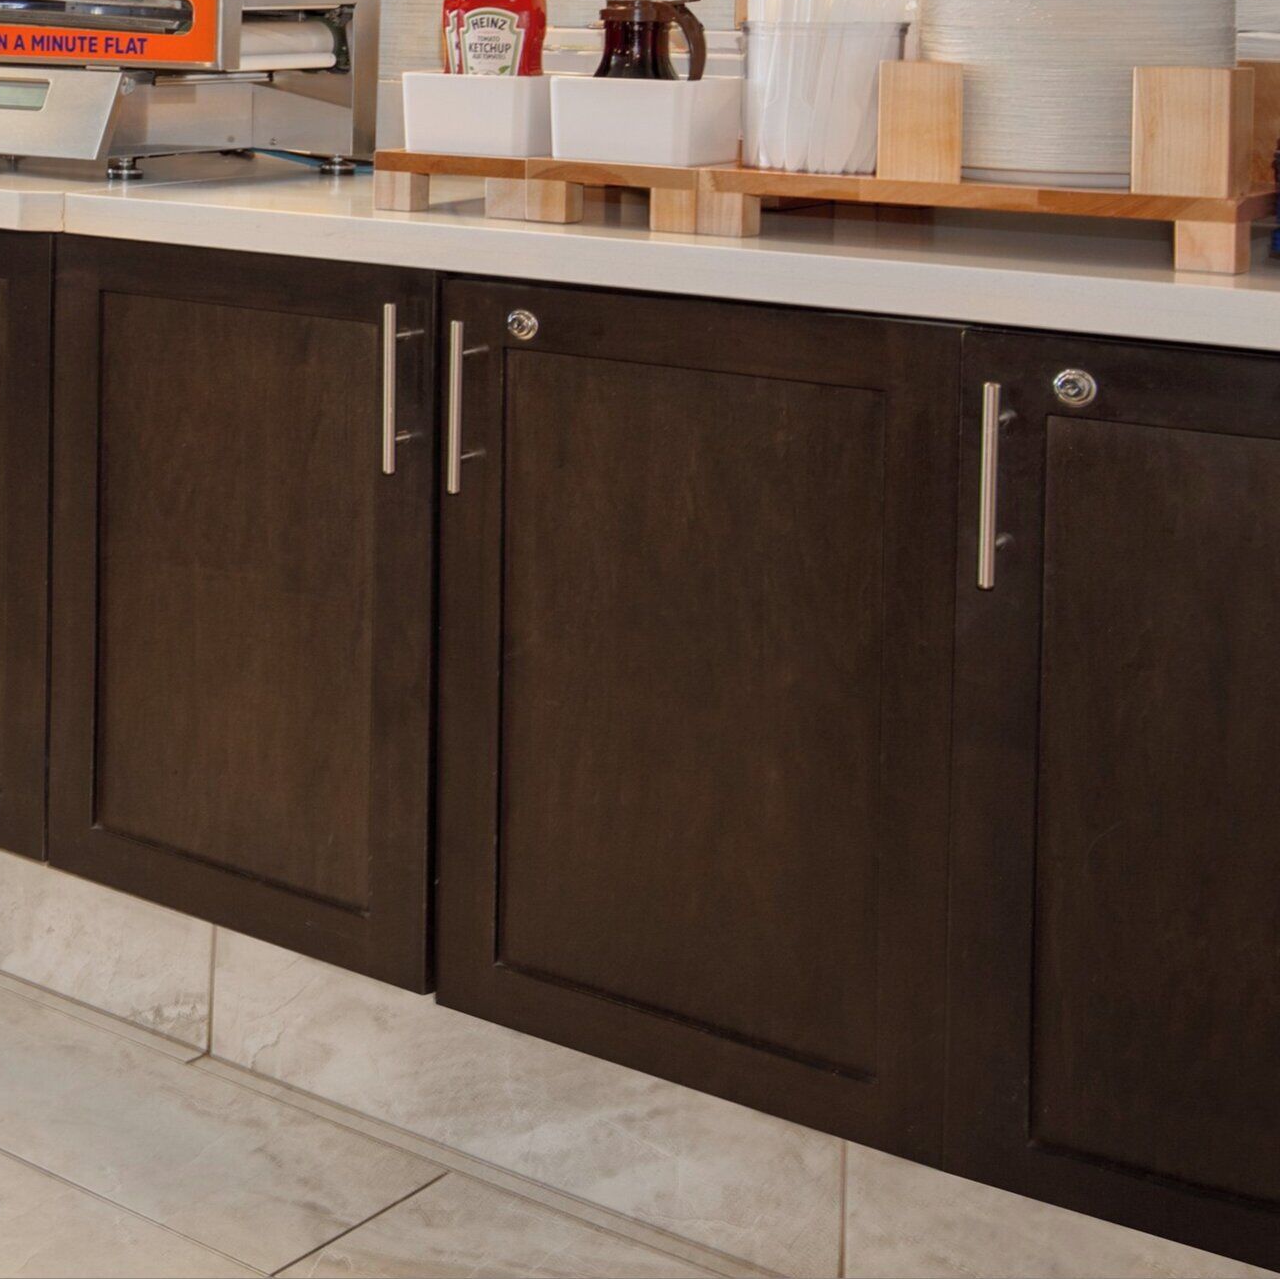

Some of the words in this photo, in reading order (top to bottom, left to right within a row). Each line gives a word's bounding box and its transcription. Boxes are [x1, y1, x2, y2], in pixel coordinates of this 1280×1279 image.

[471, 16, 508, 31] HEINZ
[13, 35, 26, 53] A
[31, 33, 100, 55] MINUTE
[104, 36, 148, 56] FLAT
[468, 42, 512, 53] KETCHUP
